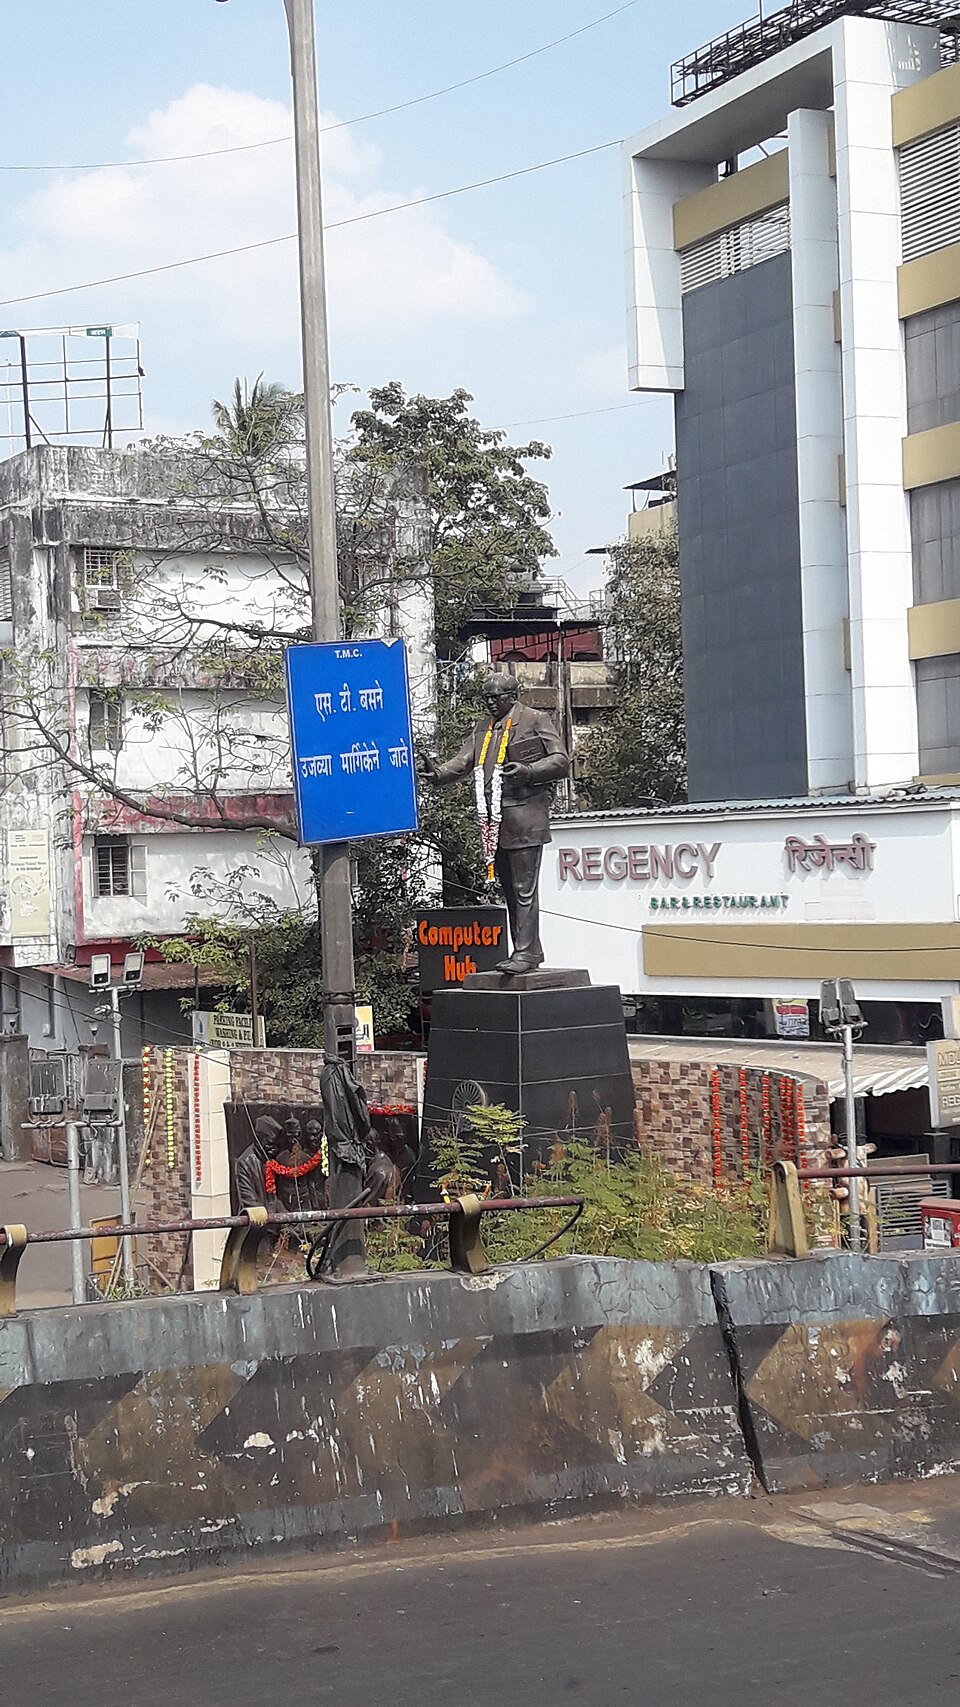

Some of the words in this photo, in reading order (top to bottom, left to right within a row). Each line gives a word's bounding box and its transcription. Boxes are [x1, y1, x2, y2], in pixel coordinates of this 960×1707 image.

[335, 649, 362, 658] T.M.C.
[314, 693, 336, 722] एस.
[339, 683, 356, 711] टी.
[359, 680, 383, 711] बसने
[300, 755, 332, 778] उजव्या
[340, 742, 379, 774] मार्गिकेने
[388, 738, 409, 767] जावे
[559, 843, 722, 881] REGENCY
[784, 833, 878, 872] रिजेन्सी
[418, 920, 502, 952] Computer
[444, 955, 477, 981] Hub
